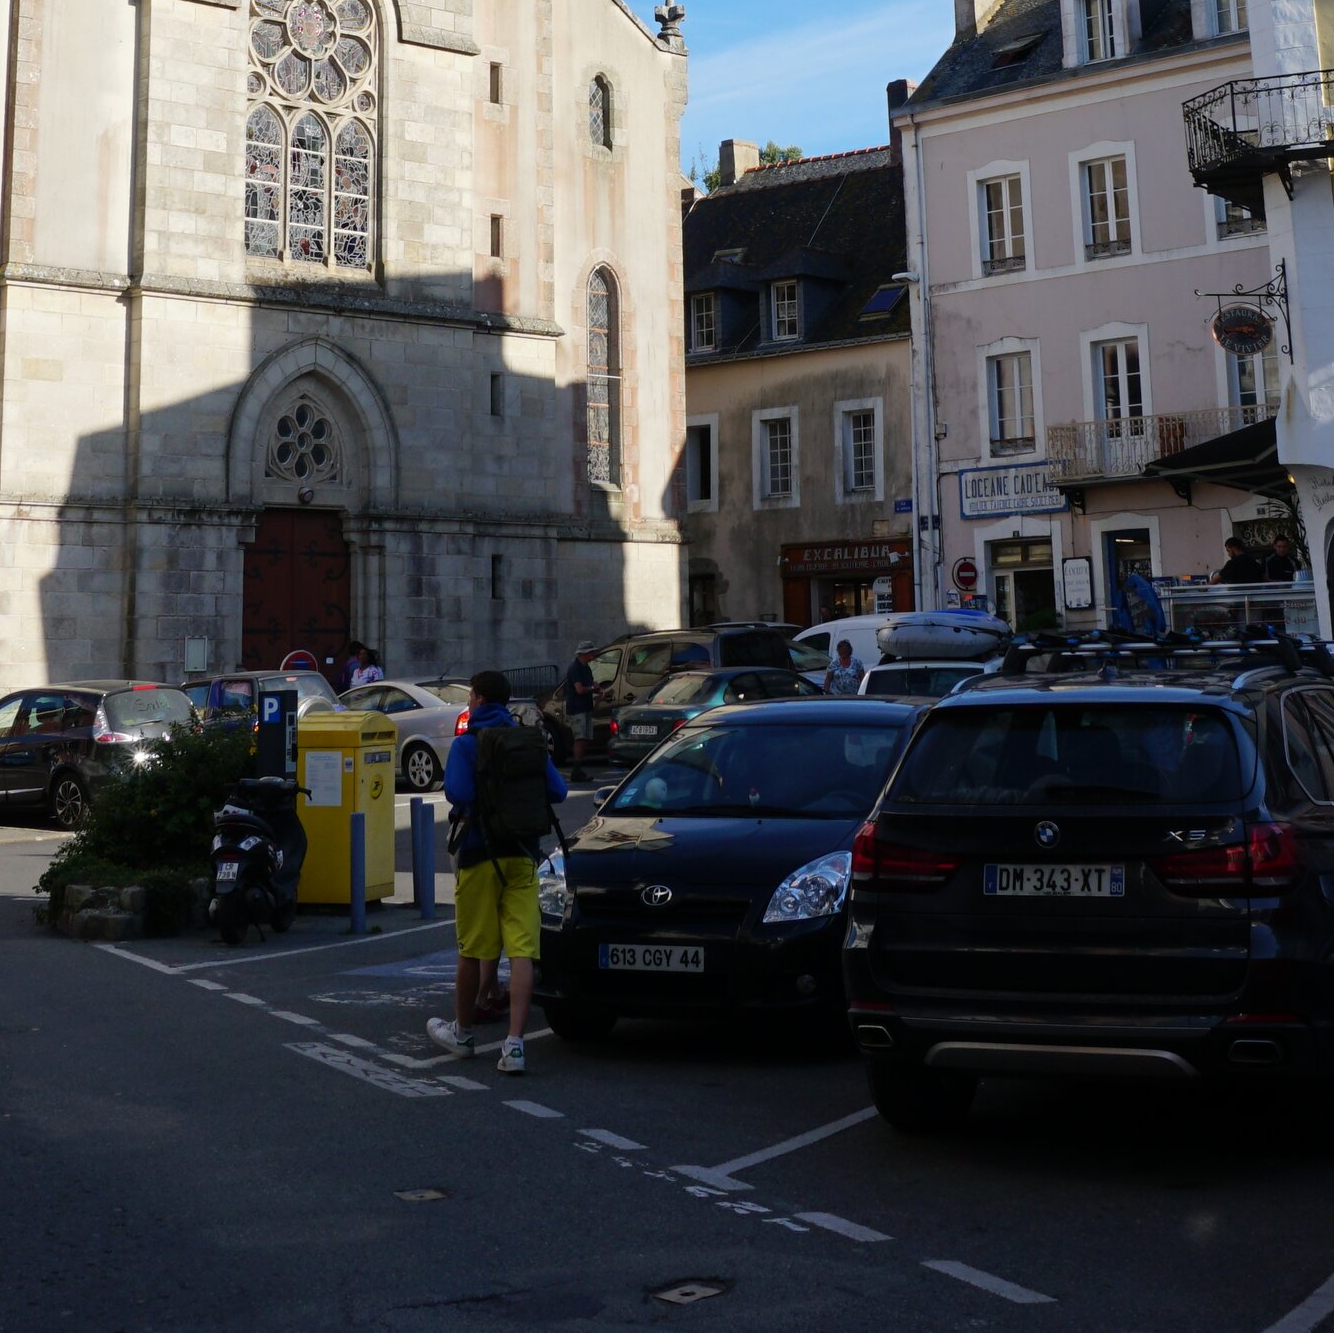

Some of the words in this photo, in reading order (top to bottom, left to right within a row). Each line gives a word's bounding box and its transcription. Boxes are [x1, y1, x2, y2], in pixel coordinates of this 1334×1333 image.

[1234, 335, 1270, 353] VIVIER
[964, 476, 1009, 499] L'OCEANE
[803, 545, 891, 561] EXCALIBUR
[263, 697, 279, 722] P
[1161, 830, 1207, 842] X5
[998, 868, 1107, 892] DM-343-XT
[1111, 881, 1124, 893] 80
[610, 948, 636, 965] 613
[642, 949, 673, 967] CGY
[679, 950, 701, 968] 44
